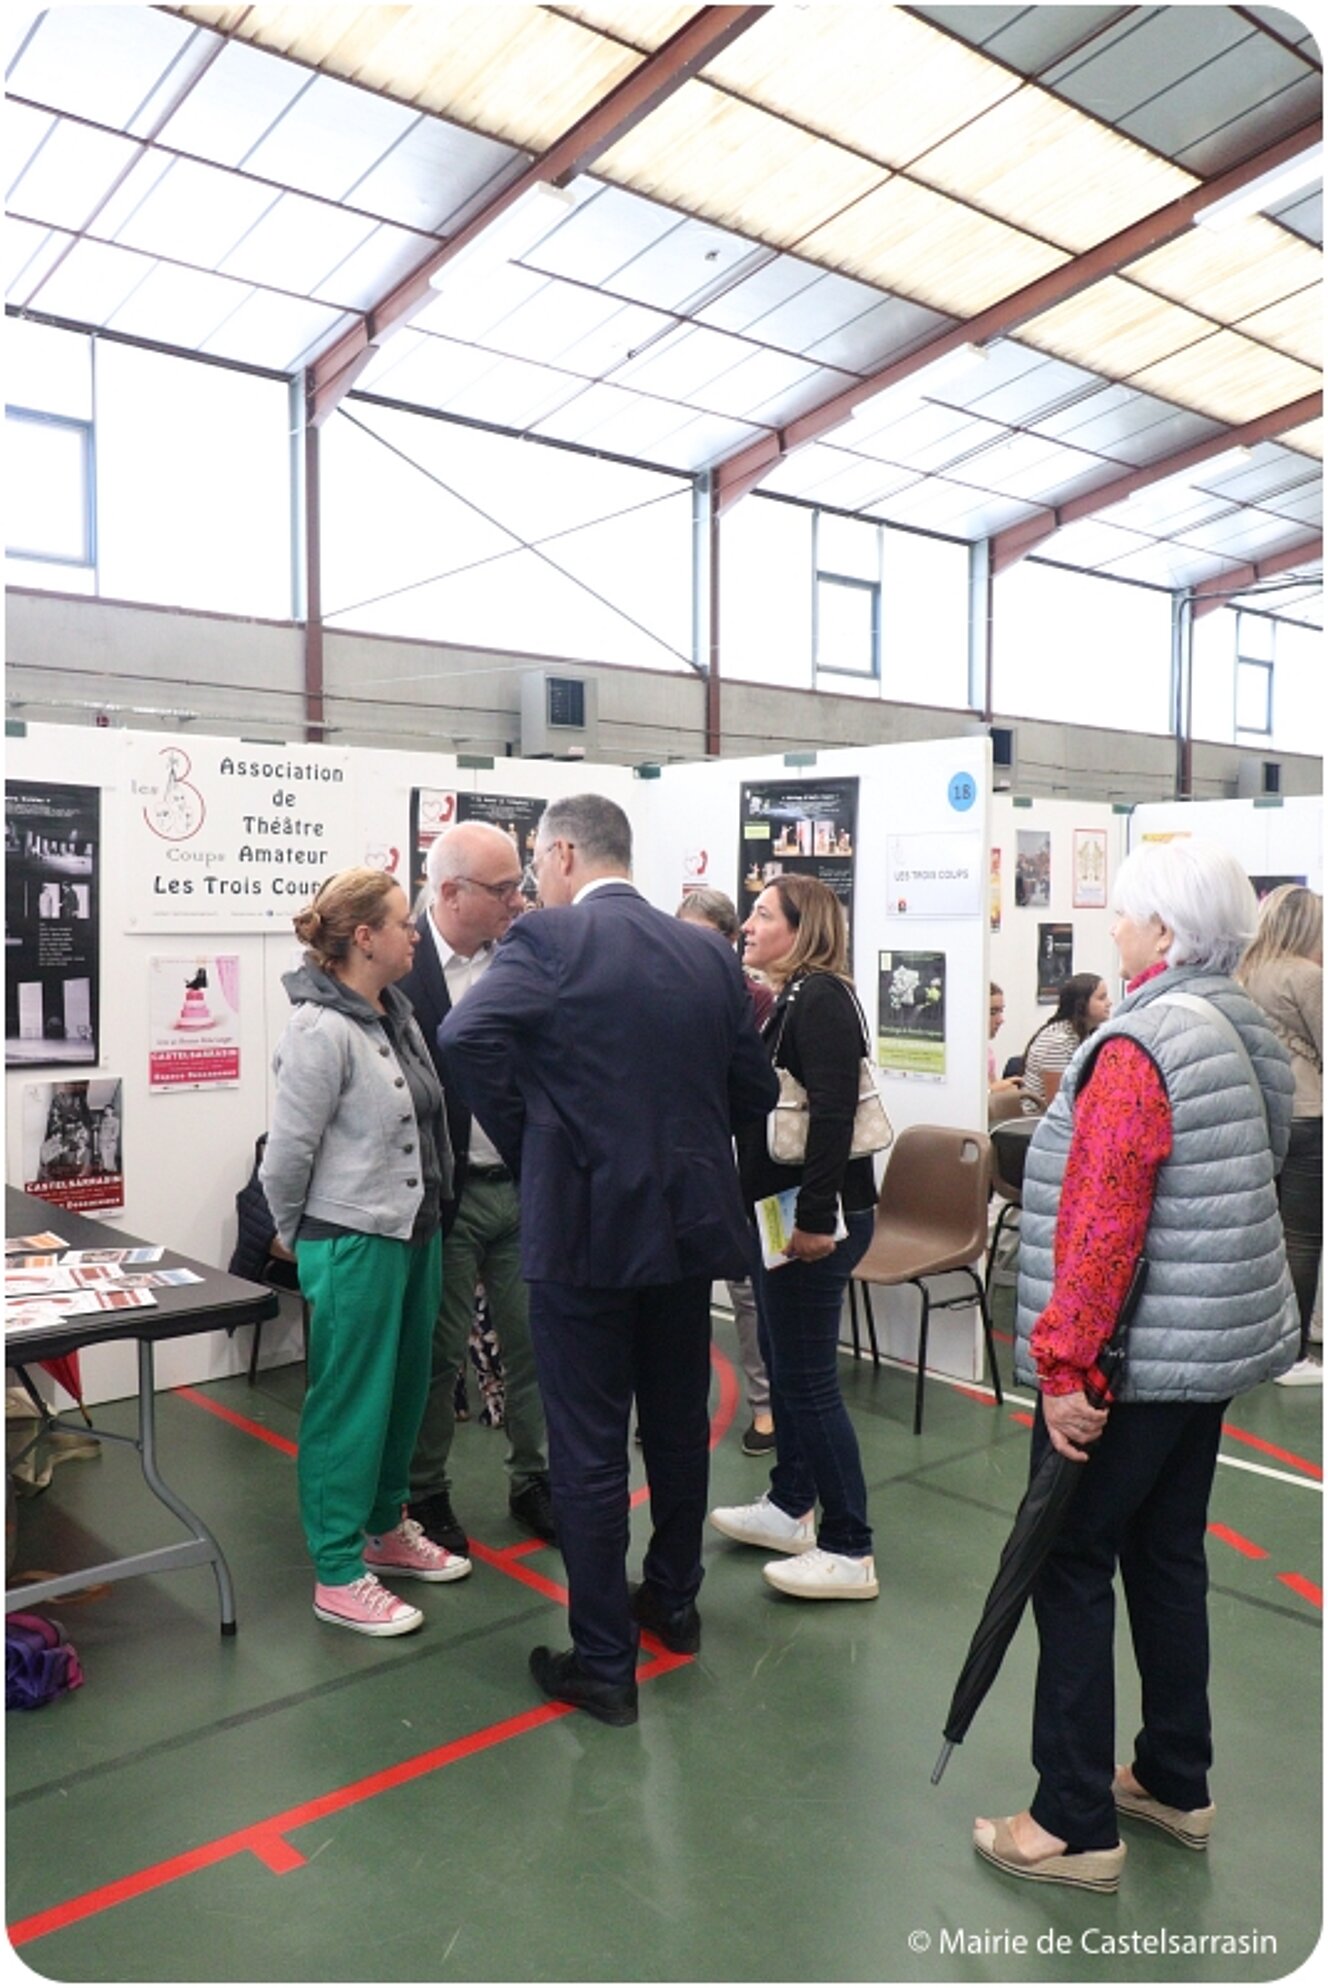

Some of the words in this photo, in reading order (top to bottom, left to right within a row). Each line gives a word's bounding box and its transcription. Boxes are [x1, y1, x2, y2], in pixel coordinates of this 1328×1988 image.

[220, 757, 344, 782] Association
[131, 780, 158, 795] les
[272, 789, 296, 807] de
[243, 816, 324, 836] Théâtre
[238, 846, 328, 864] Amateur
[154, 876, 194, 895] Les
[204, 876, 262, 895] Trois
